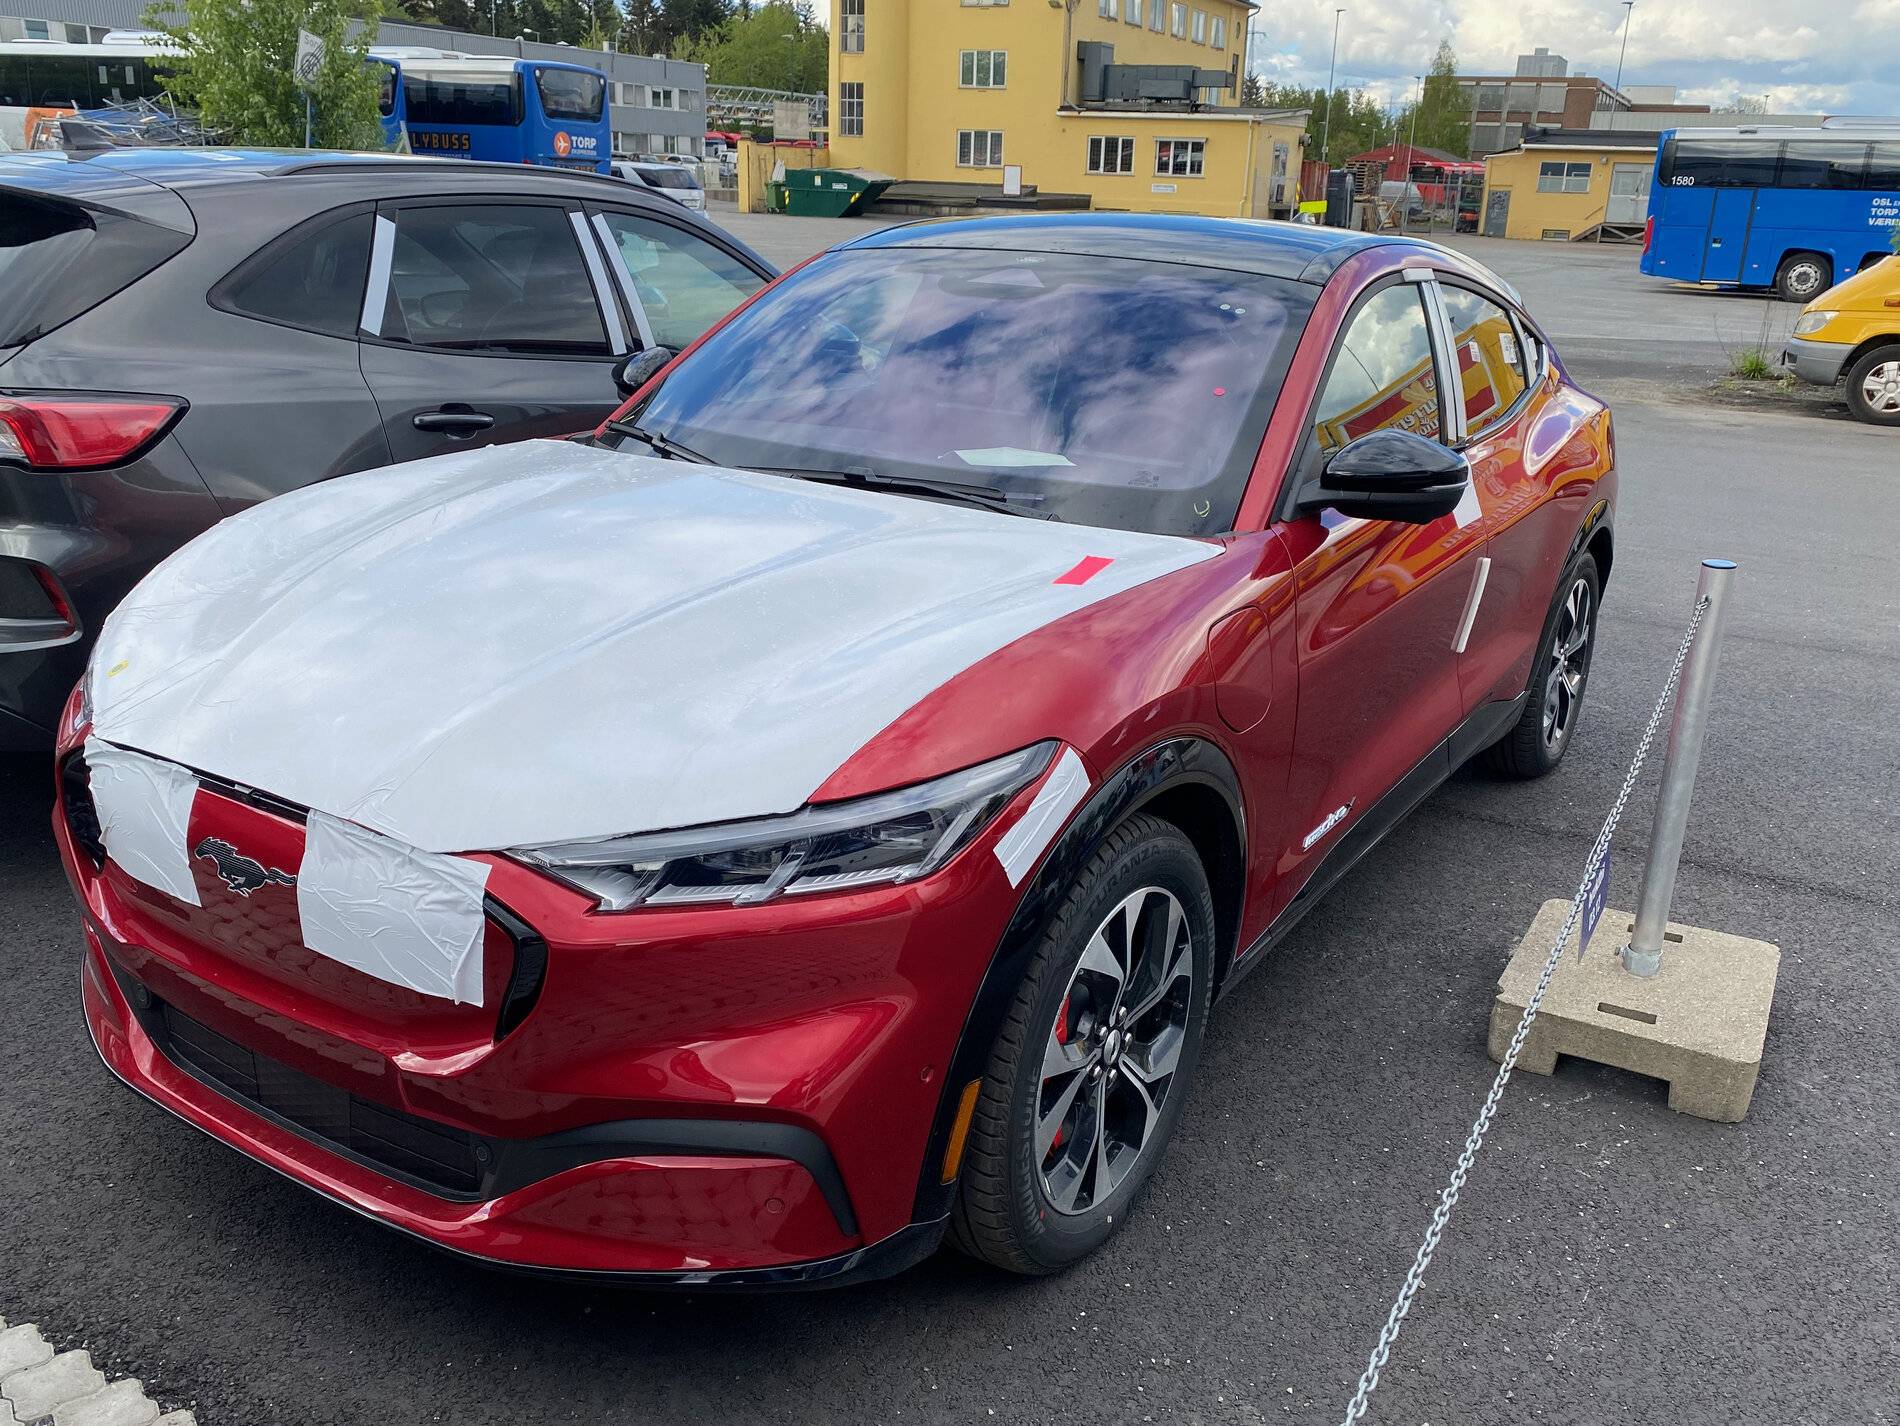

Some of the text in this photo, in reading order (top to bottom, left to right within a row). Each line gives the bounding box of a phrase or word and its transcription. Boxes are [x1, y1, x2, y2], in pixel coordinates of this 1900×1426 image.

[409, 131, 470, 150] LYBUSS
[571, 135, 597, 149] TORP
[1671, 175, 1695, 186] 1580
[1872, 197, 1893, 206] OSL
[1870, 207, 1899, 216] TORP
